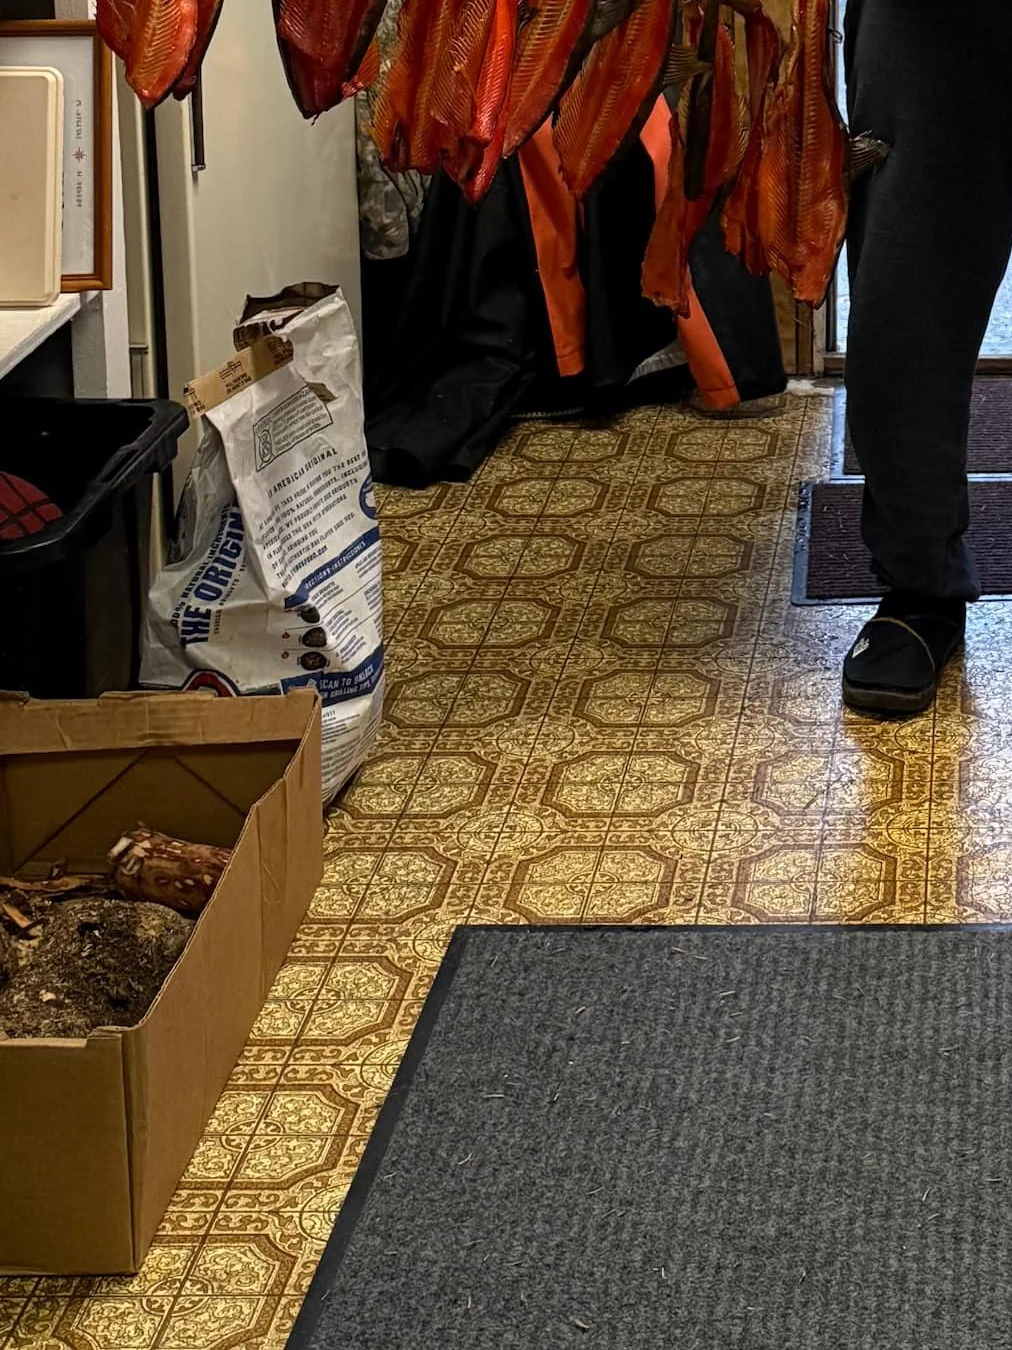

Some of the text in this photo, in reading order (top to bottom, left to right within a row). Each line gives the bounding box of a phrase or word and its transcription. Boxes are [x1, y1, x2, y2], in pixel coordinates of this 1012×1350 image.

[180, 500, 245, 648] THE ORIGIN
[181, 561, 209, 599] NATURAL
